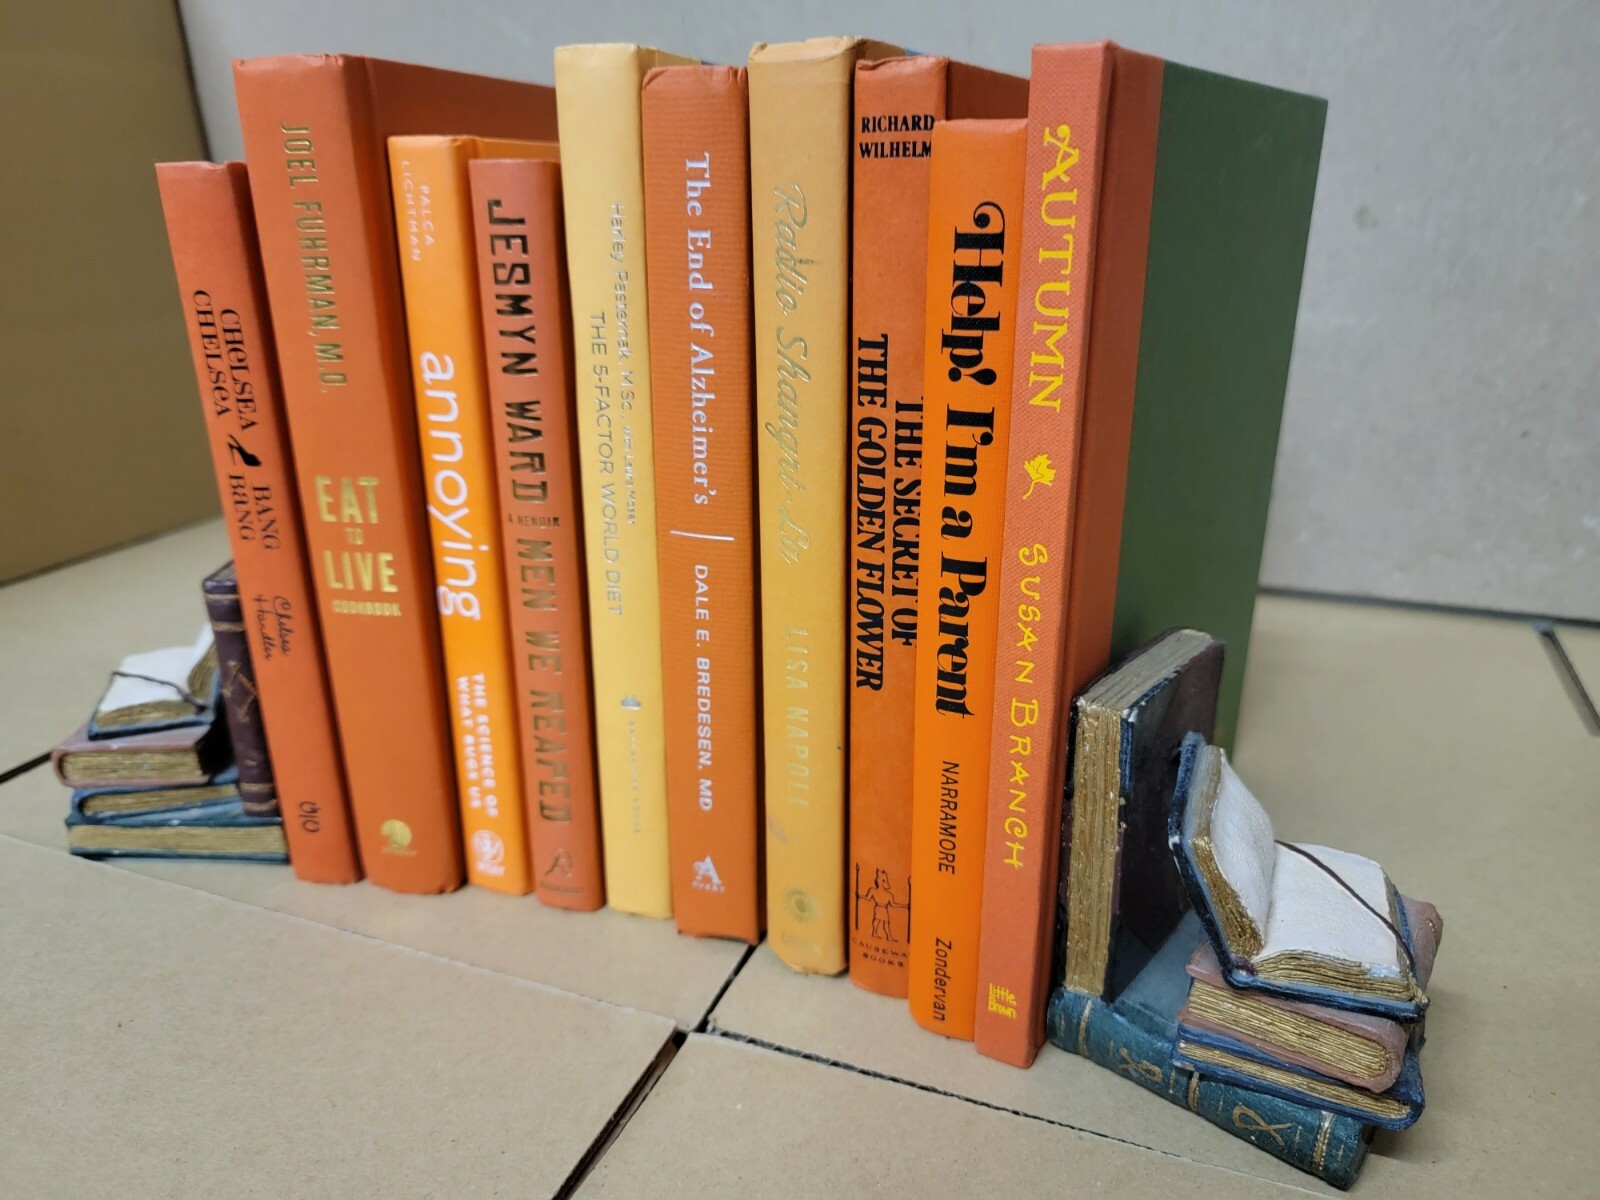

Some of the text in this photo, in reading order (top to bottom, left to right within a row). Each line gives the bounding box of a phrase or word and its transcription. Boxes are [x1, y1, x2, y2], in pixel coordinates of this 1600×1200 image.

[280, 122, 319, 189] JOEL
[859, 140, 932, 159] WILHELM
[861, 114, 936, 133] RICHARD
[401, 160, 421, 262] LICHTMAN
[419, 184, 435, 248] PALCA
[774, 181, 809, 316] Radio
[293, 200, 340, 338] FUHRMAN,
[1028, 123, 1080, 413] AUTUMN
[486, 199, 549, 504] JESMYN WARD
[590, 311, 607, 356] THE
[685, 150, 717, 505] The End of Alzheimer's
[315, 475, 379, 524] EAT
[420, 351, 490, 621] annoying
[935, 201, 1006, 720] Help! I'm a Parent
[253, 484, 281, 550] BANG
[345, 527, 364, 545] TO
[601, 482, 620, 564] WORLD
[855, 333, 889, 692] THE GOLDEN FLOWER
[891, 395, 924, 650] THE SECRET OF
[323, 550, 399, 593] LIVE
[516, 538, 558, 612] MEN
[606, 569, 623, 617] DIET
[694, 564, 710, 621] DALE
[525, 630, 563, 676] WE
[695, 628, 710, 649] E.
[457, 675, 482, 810] WHAT BUGS US
[471, 672, 499, 818] THE SCIENCE OF
[786, 625, 811, 808] LISA NAPOLI
[1003, 542, 1049, 869] SUSAN BRANCH
[698, 779, 713, 812] MD
[938, 759, 960, 875] NARRAMORE
[933, 936, 953, 1022] Zondervan
